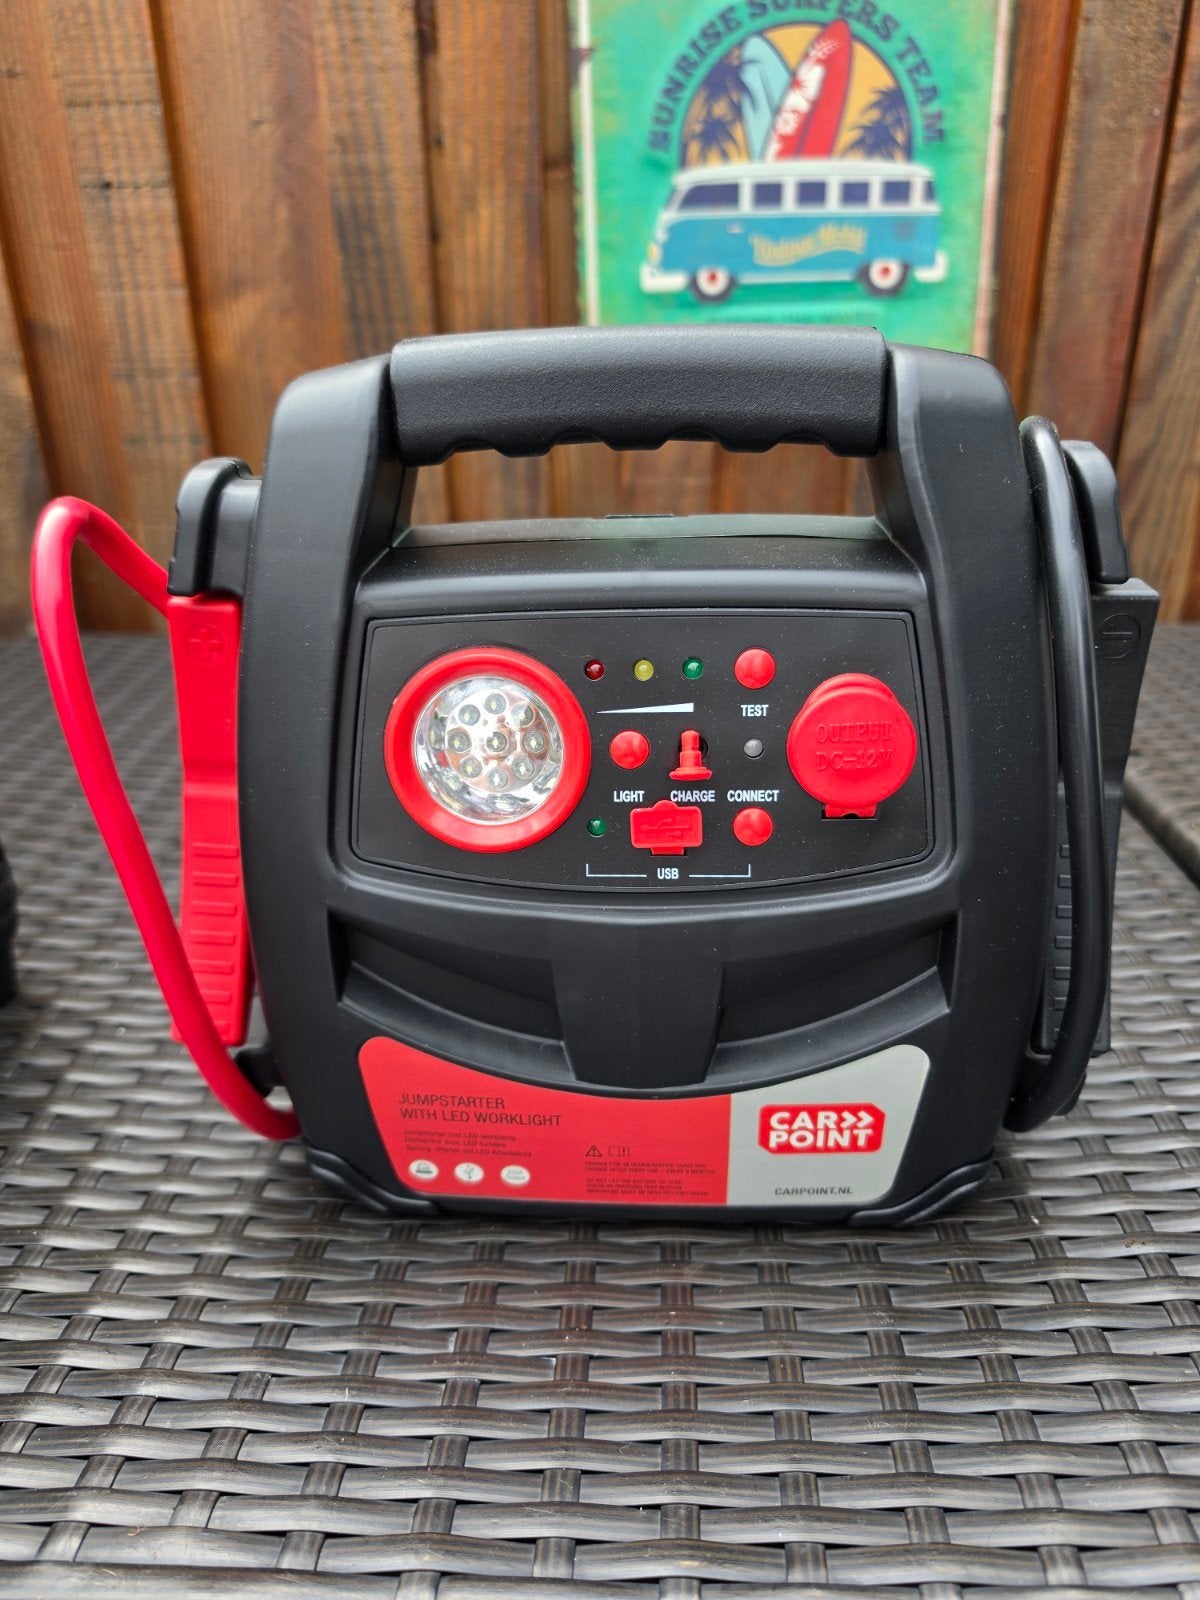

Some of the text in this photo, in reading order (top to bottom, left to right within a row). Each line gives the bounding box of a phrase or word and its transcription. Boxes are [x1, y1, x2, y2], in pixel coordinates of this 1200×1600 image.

[648, 5, 742, 153] SUNRISE
[896, 35, 946, 144] TEAM
[741, 704, 769, 717] TEST
[815, 721, 894, 744] OUTPUT
[815, 749, 894, 772] DC-12V
[613, 790, 780, 803] LIGHT CHARGE CONNECT
[657, 868, 680, 881] USB
[398, 1093, 506, 1109] JUMPSTARTER
[400, 1107, 563, 1127] WITH LED WORKLIGHT
[769, 1110, 838, 1130] CAR
[768, 1128, 873, 1149] POINT
[774, 1186, 853, 1196] CARPOINT.NL
